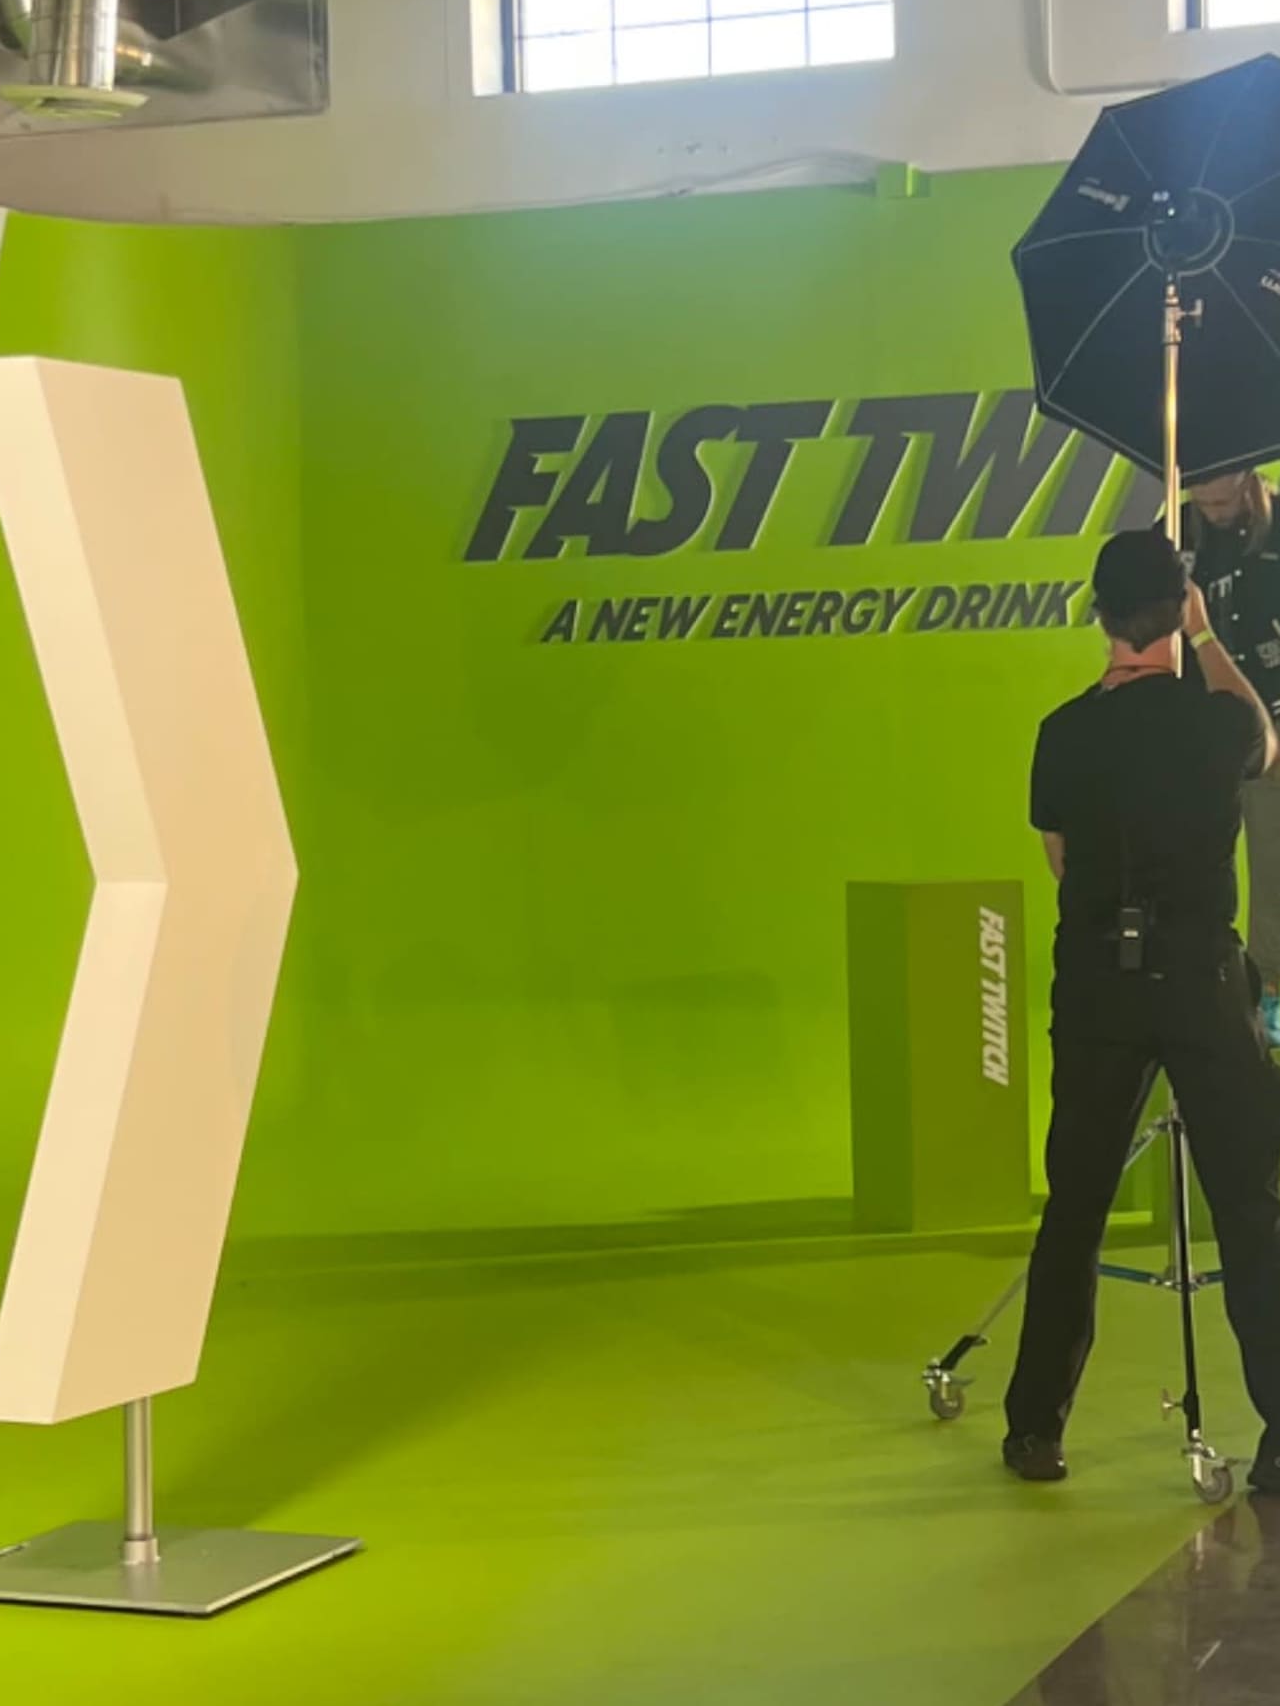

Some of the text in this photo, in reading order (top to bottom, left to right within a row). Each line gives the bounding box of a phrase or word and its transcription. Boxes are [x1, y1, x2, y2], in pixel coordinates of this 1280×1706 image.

[462, 398, 836, 562] FAST
[540, 599, 580, 644] A
[588, 595, 713, 643] NEW
[710, 587, 919, 639] ENERGY
[919, 581, 1086, 631] DRINK
[979, 906, 1010, 1087] FAST TWITCH
